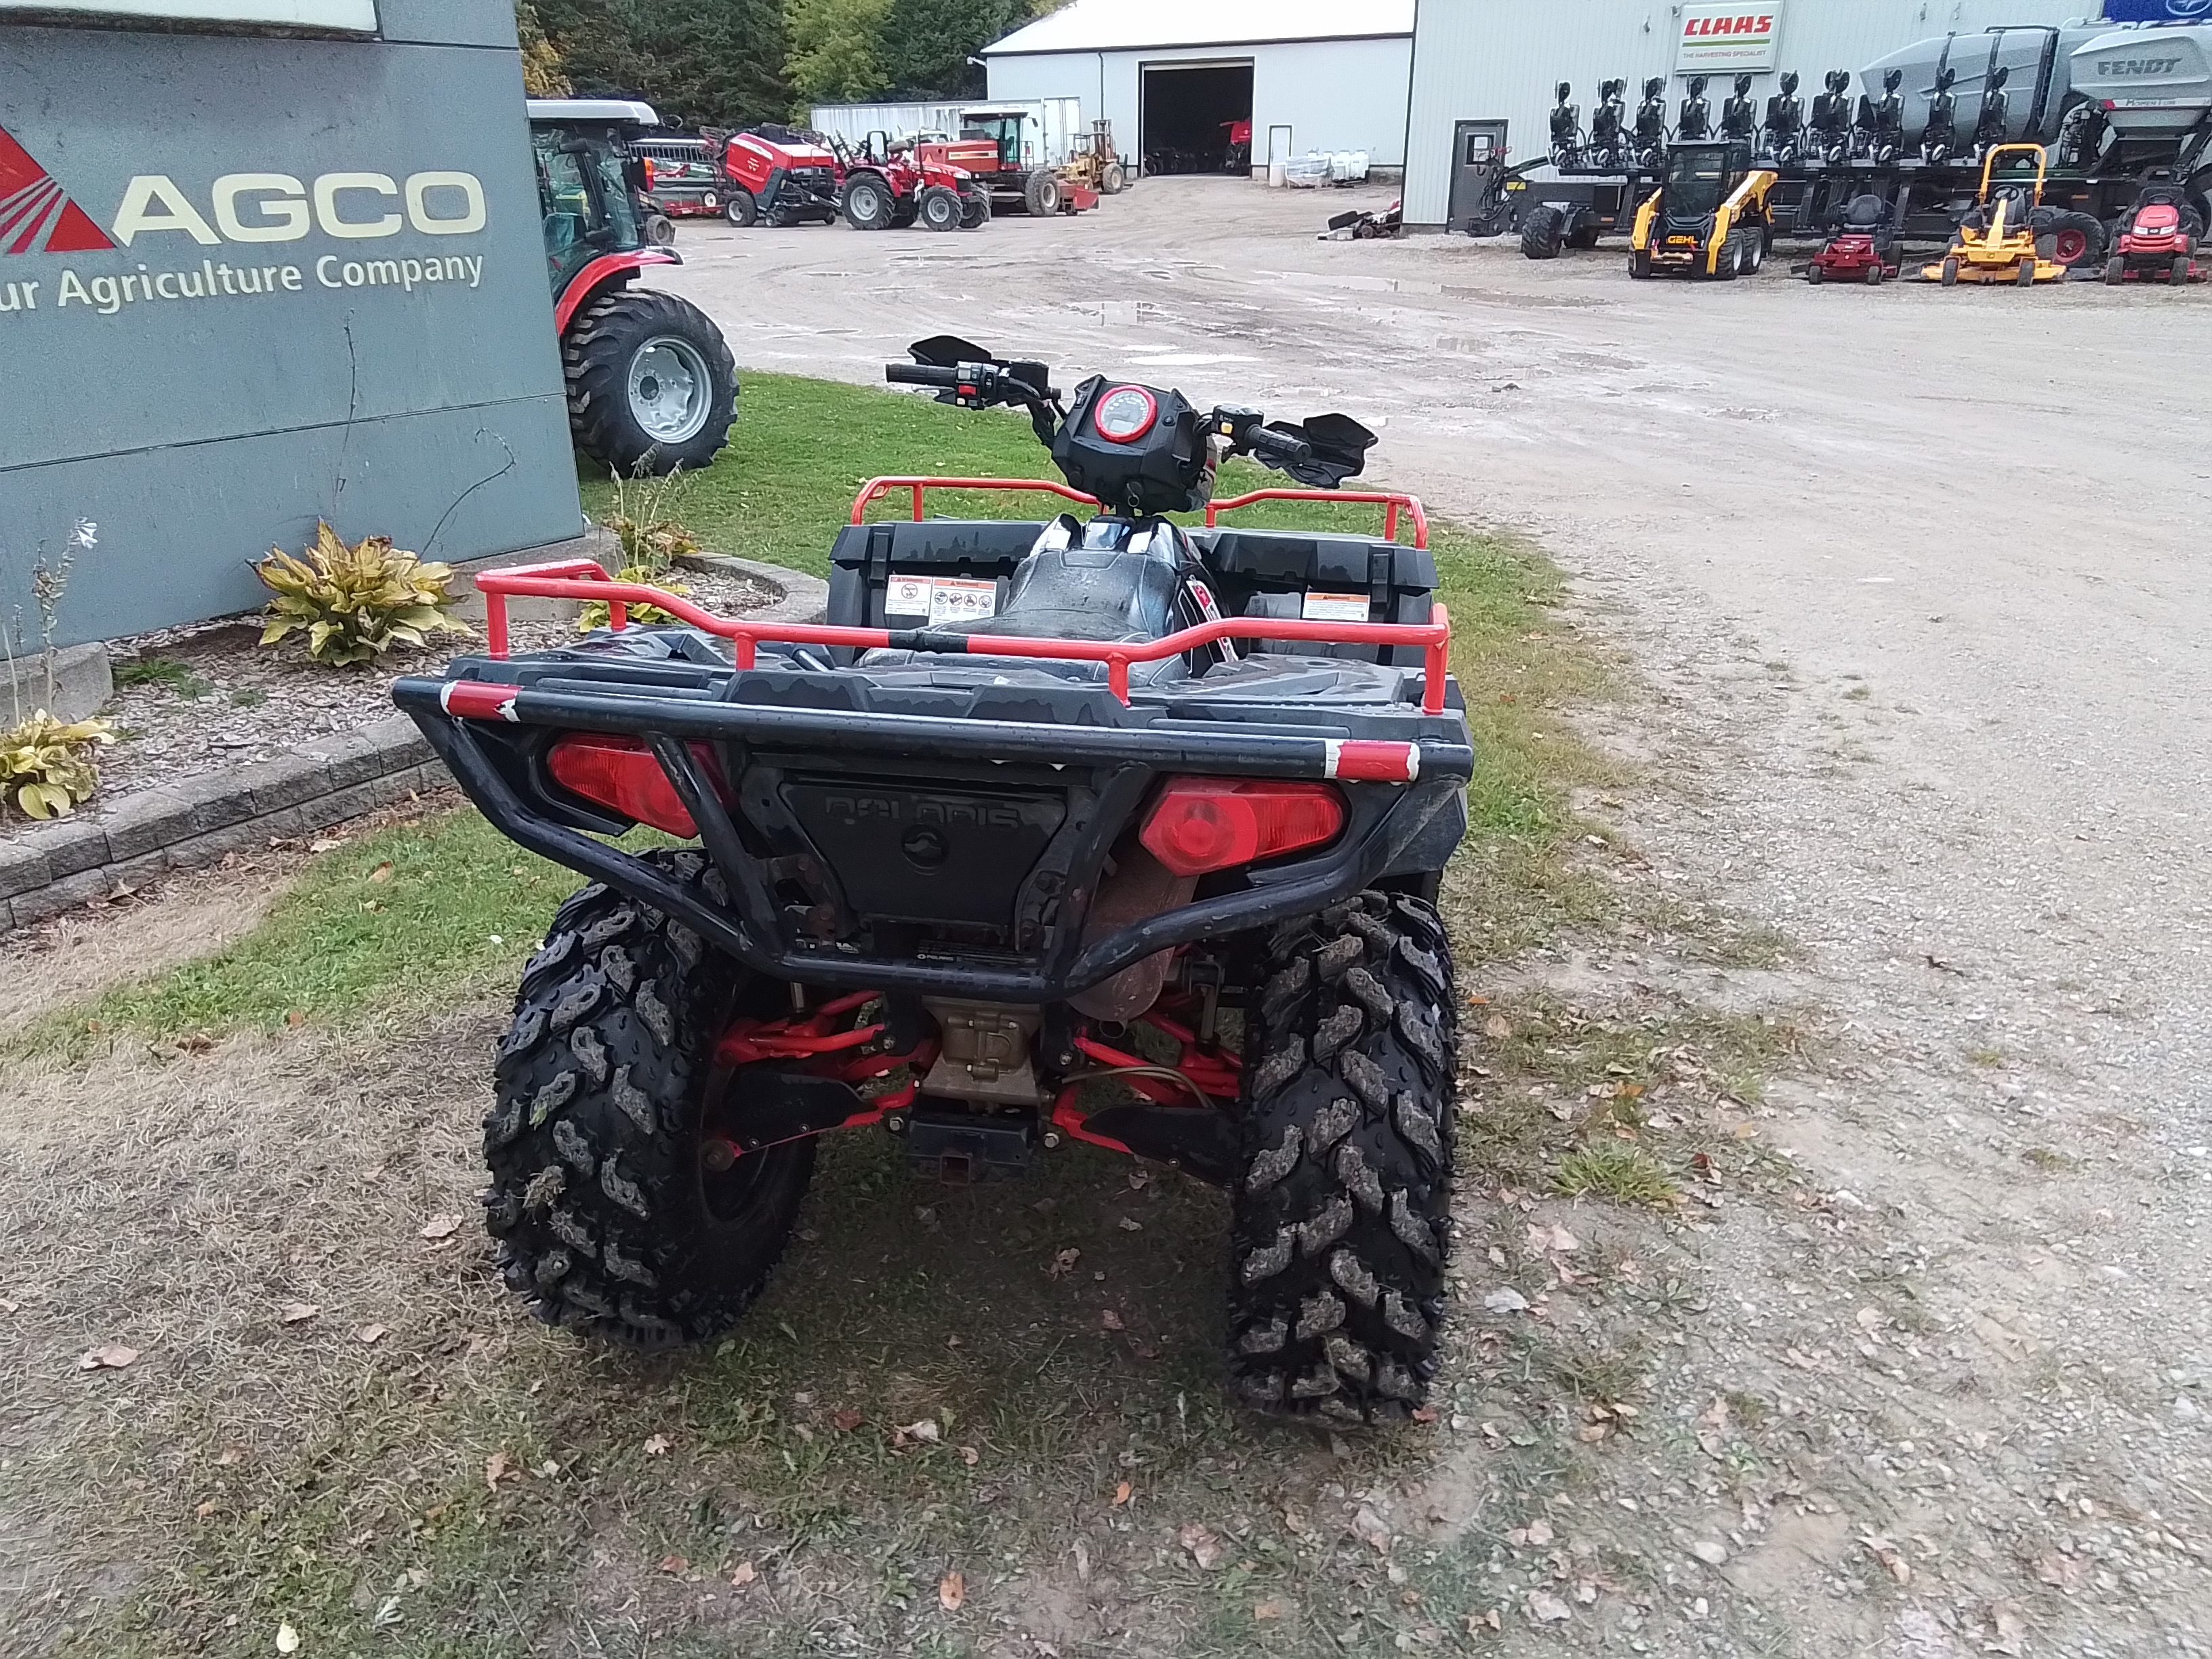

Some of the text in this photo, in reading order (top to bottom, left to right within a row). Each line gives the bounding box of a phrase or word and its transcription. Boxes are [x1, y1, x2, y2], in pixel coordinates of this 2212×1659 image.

[1684, 15, 1774, 36] CLAAS
[2097, 58, 2183, 75] FENDT
[110, 171, 487, 247] AGCO
[1667, 235, 1698, 243] GEHL
[58, 259, 303, 314] Agriculture
[316, 254, 483, 292] Company
[825, 796, 1019, 829] POLARIS
